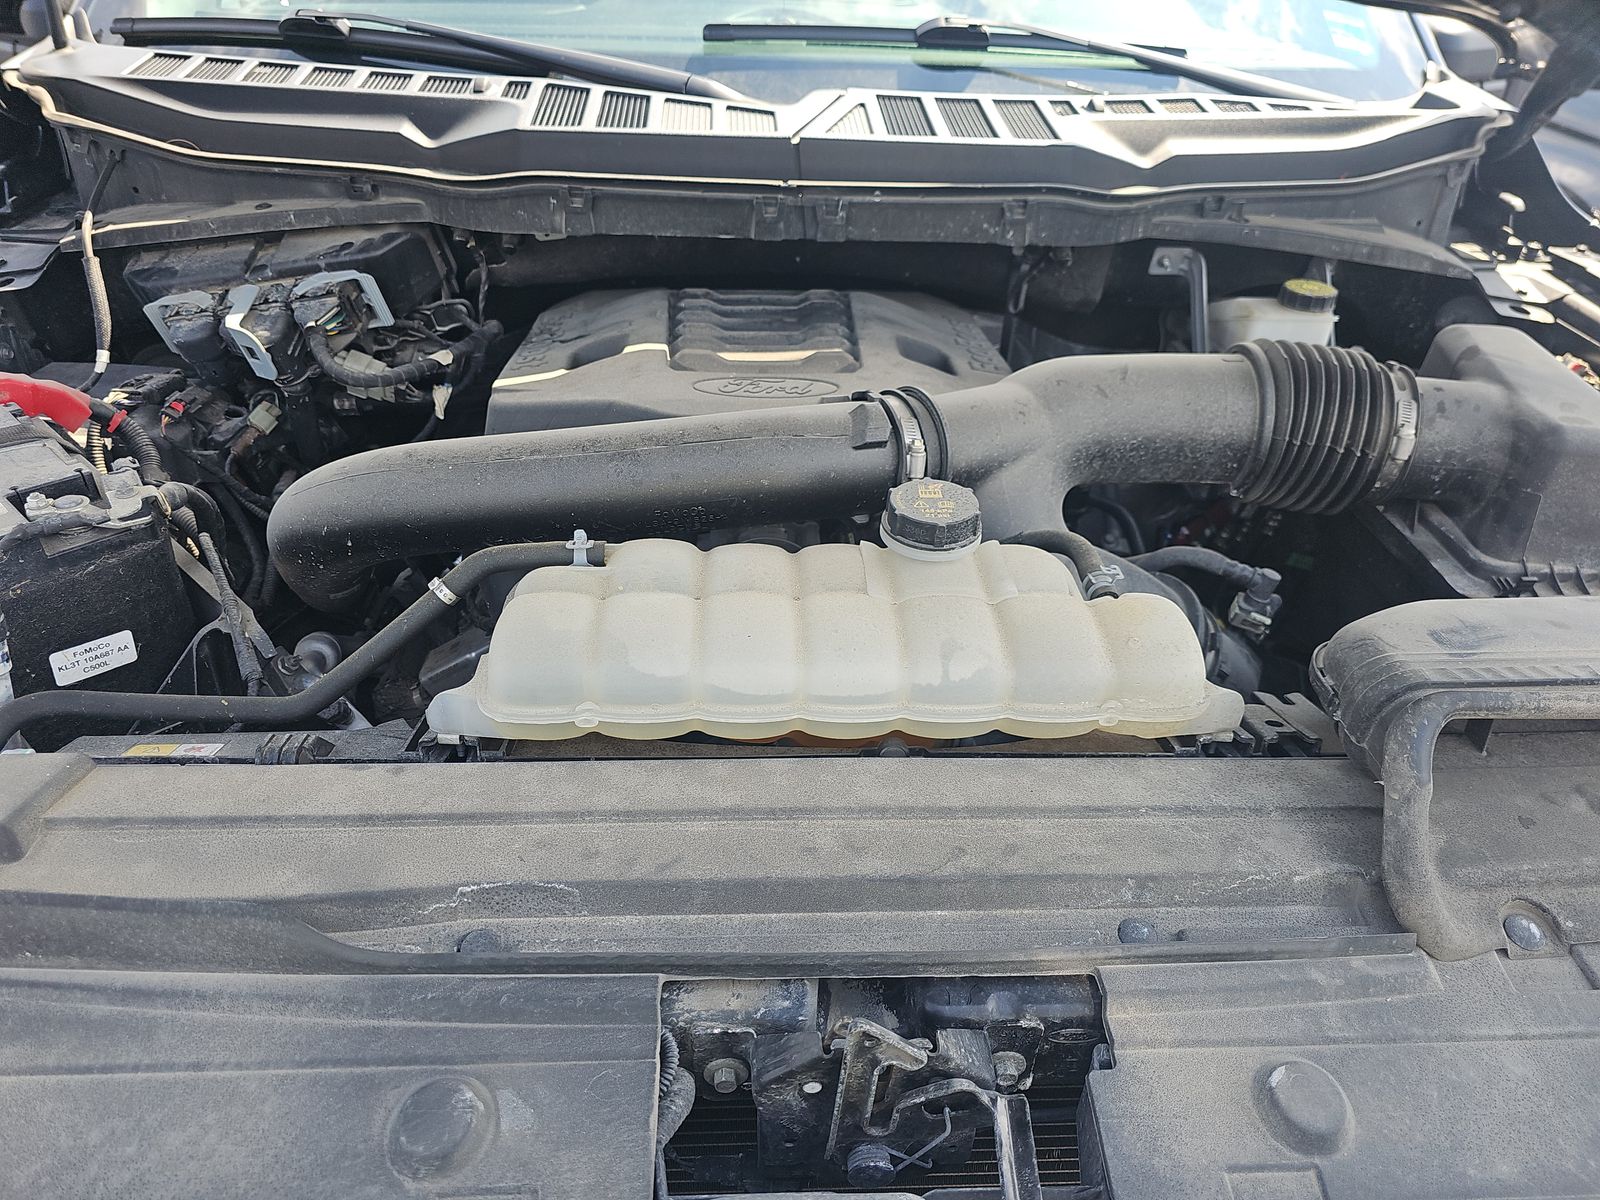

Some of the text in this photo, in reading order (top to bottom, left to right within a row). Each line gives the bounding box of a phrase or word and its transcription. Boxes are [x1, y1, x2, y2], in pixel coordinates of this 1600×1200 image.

[718, 378, 813, 394] Ford
[72, 642, 111, 658] FoMoCo
[57, 644, 130, 673] KL3T 10A687 AA
[82, 660, 111, 673] C500L
